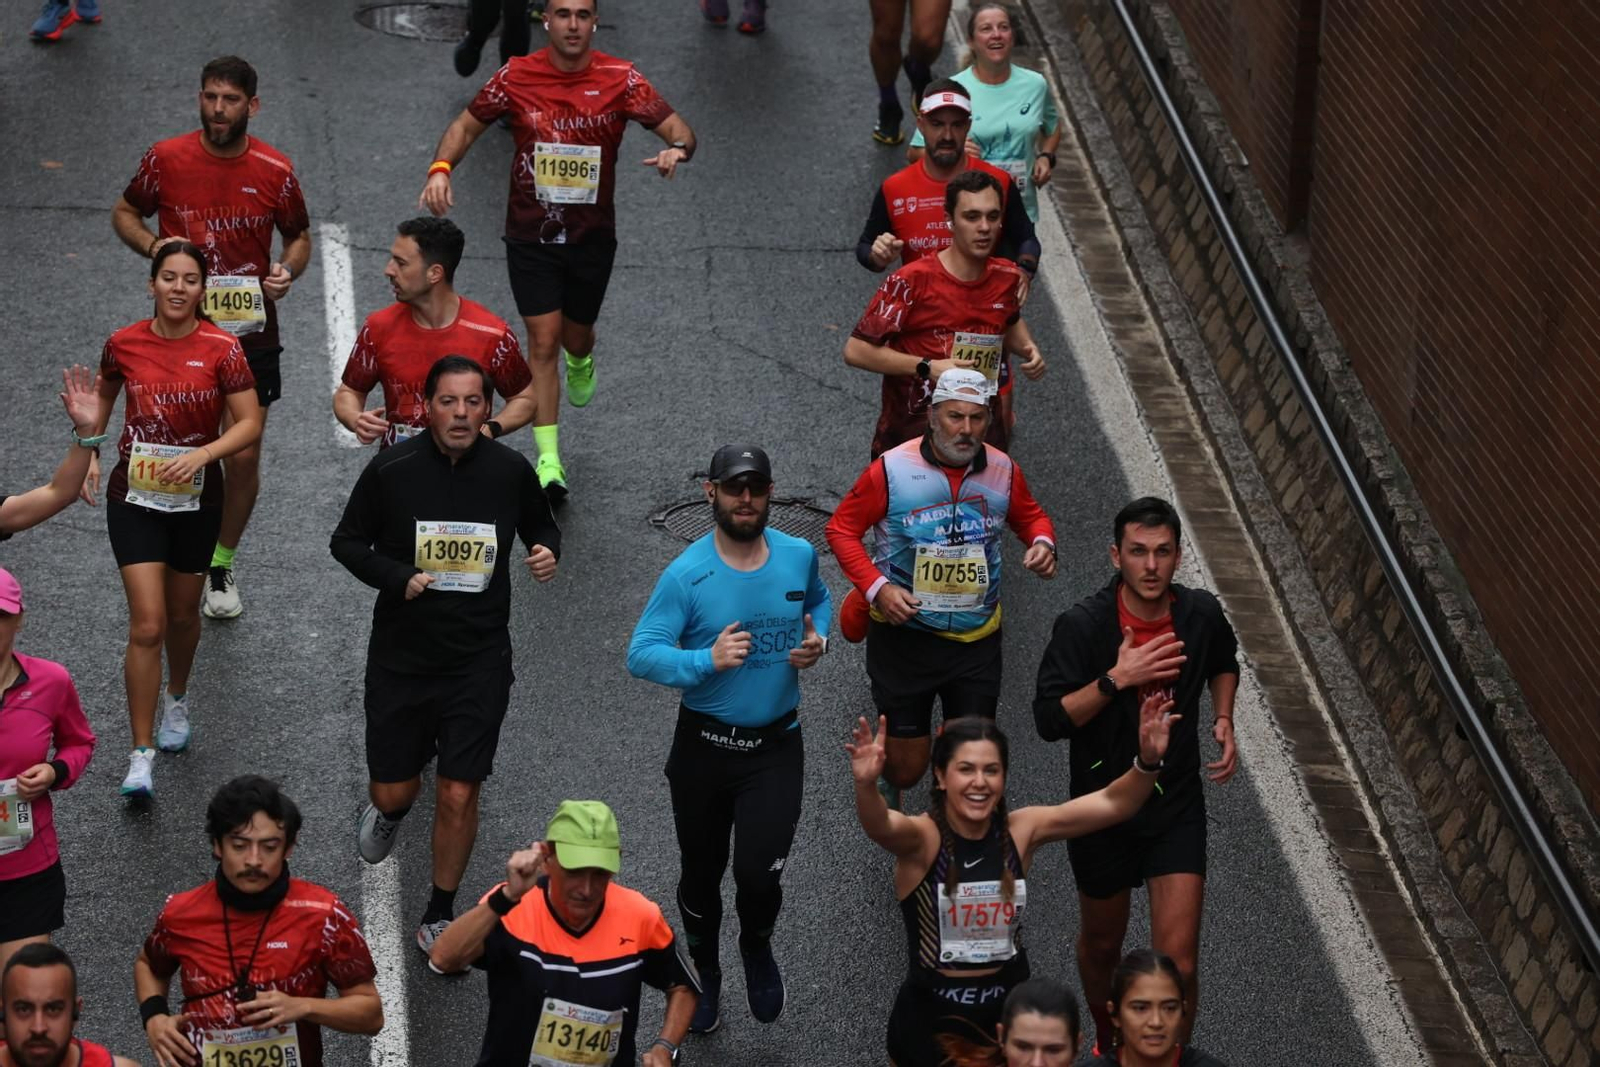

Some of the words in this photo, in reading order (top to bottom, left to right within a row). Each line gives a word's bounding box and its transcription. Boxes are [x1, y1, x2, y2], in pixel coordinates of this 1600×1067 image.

[540, 158, 589, 178] 11996
[203, 292, 253, 311] 11409
[956, 348, 997, 369] 14516
[423, 539, 485, 562] 13097
[922, 561, 977, 583] 10755
[766, 617, 788, 629] DELS
[948, 901, 1016, 928] 17579
[546, 1020, 611, 1052] 13140
[211, 1044, 284, 1067] 13629
